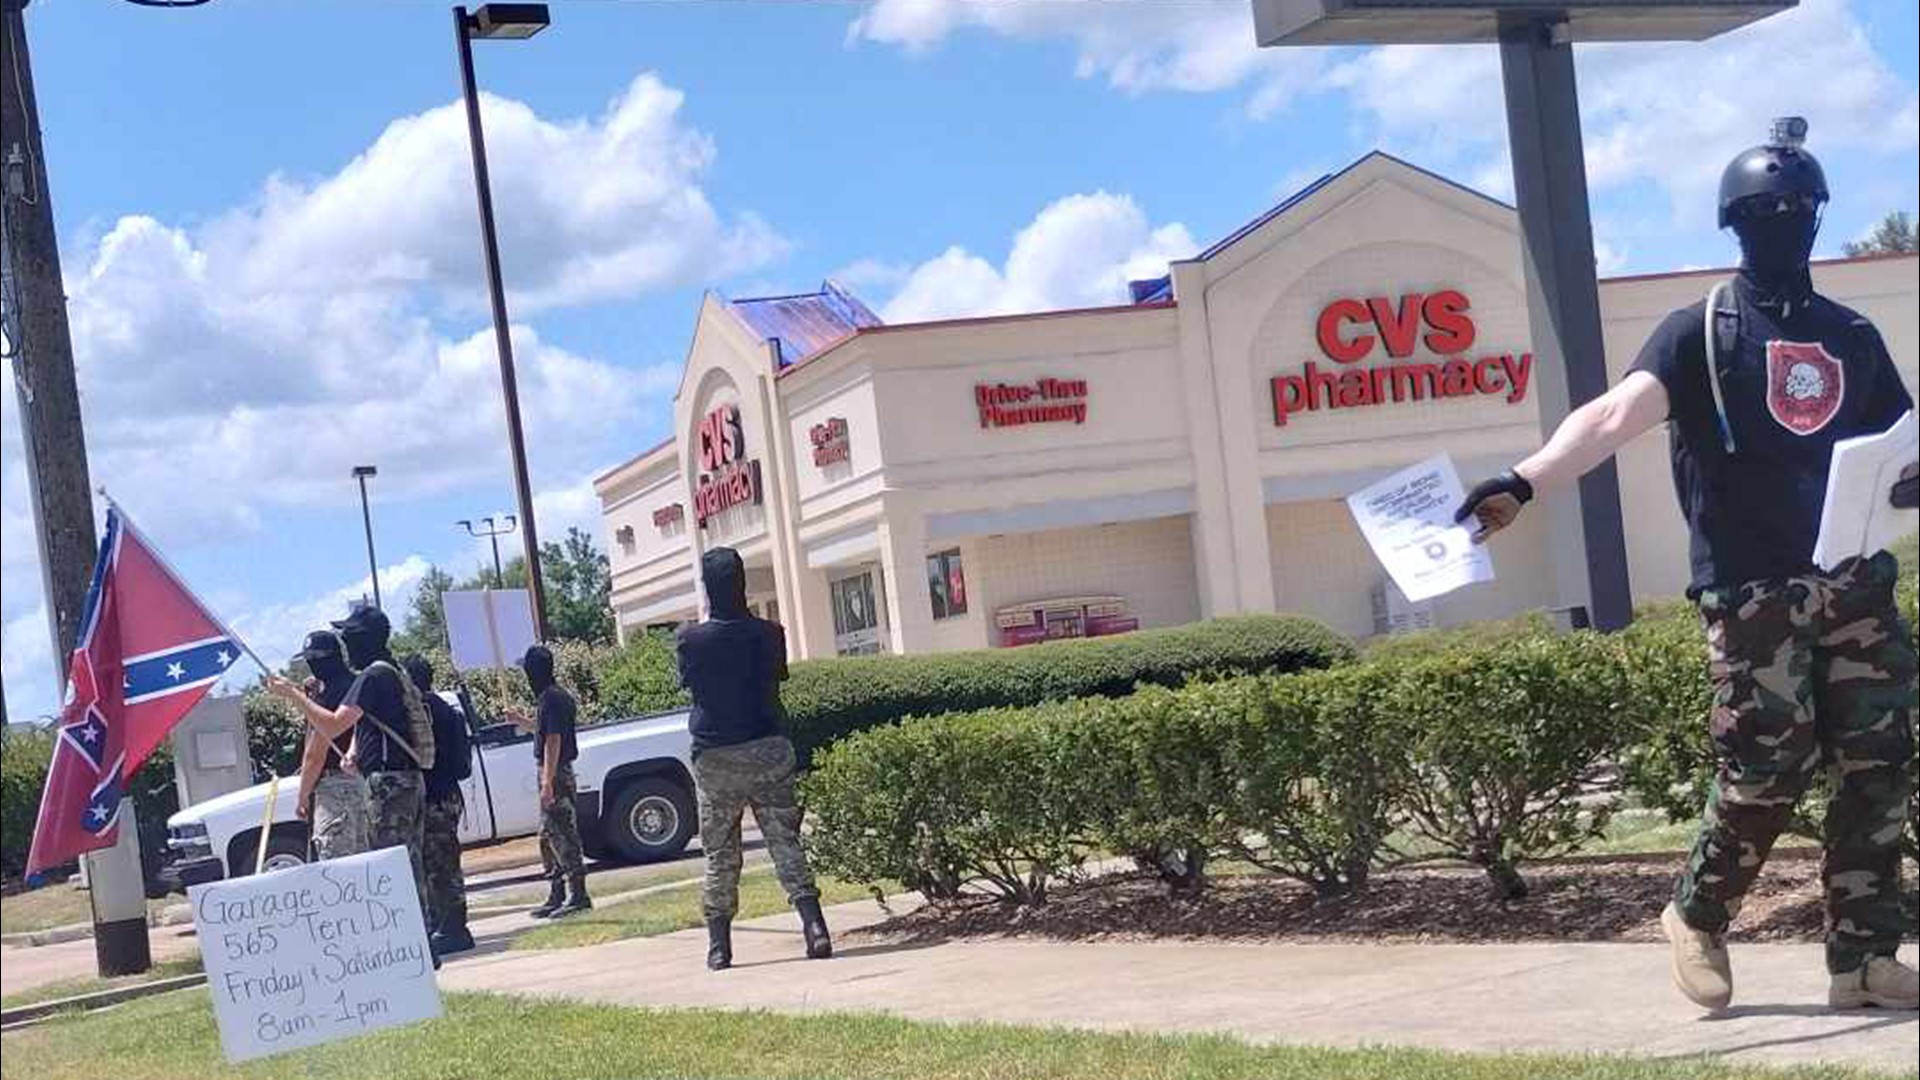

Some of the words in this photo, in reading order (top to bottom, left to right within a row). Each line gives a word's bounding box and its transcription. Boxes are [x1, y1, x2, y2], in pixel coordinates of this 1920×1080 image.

[1317, 290, 1475, 364] CVS
[975, 377, 1088, 408] Drive-Thru
[980, 403, 1087, 429] Pharmacy
[1271, 353, 1532, 426] pharmacy
[698, 405, 745, 471] CVS
[199, 887, 314, 929] Garage
[320, 861, 393, 907] Sale
[223, 923, 278, 961] 565
[300, 910, 362, 944] Teri
[365, 898, 406, 933] Dr
[224, 965, 307, 1006] Friday
[322, 942, 425, 984] Saturday
